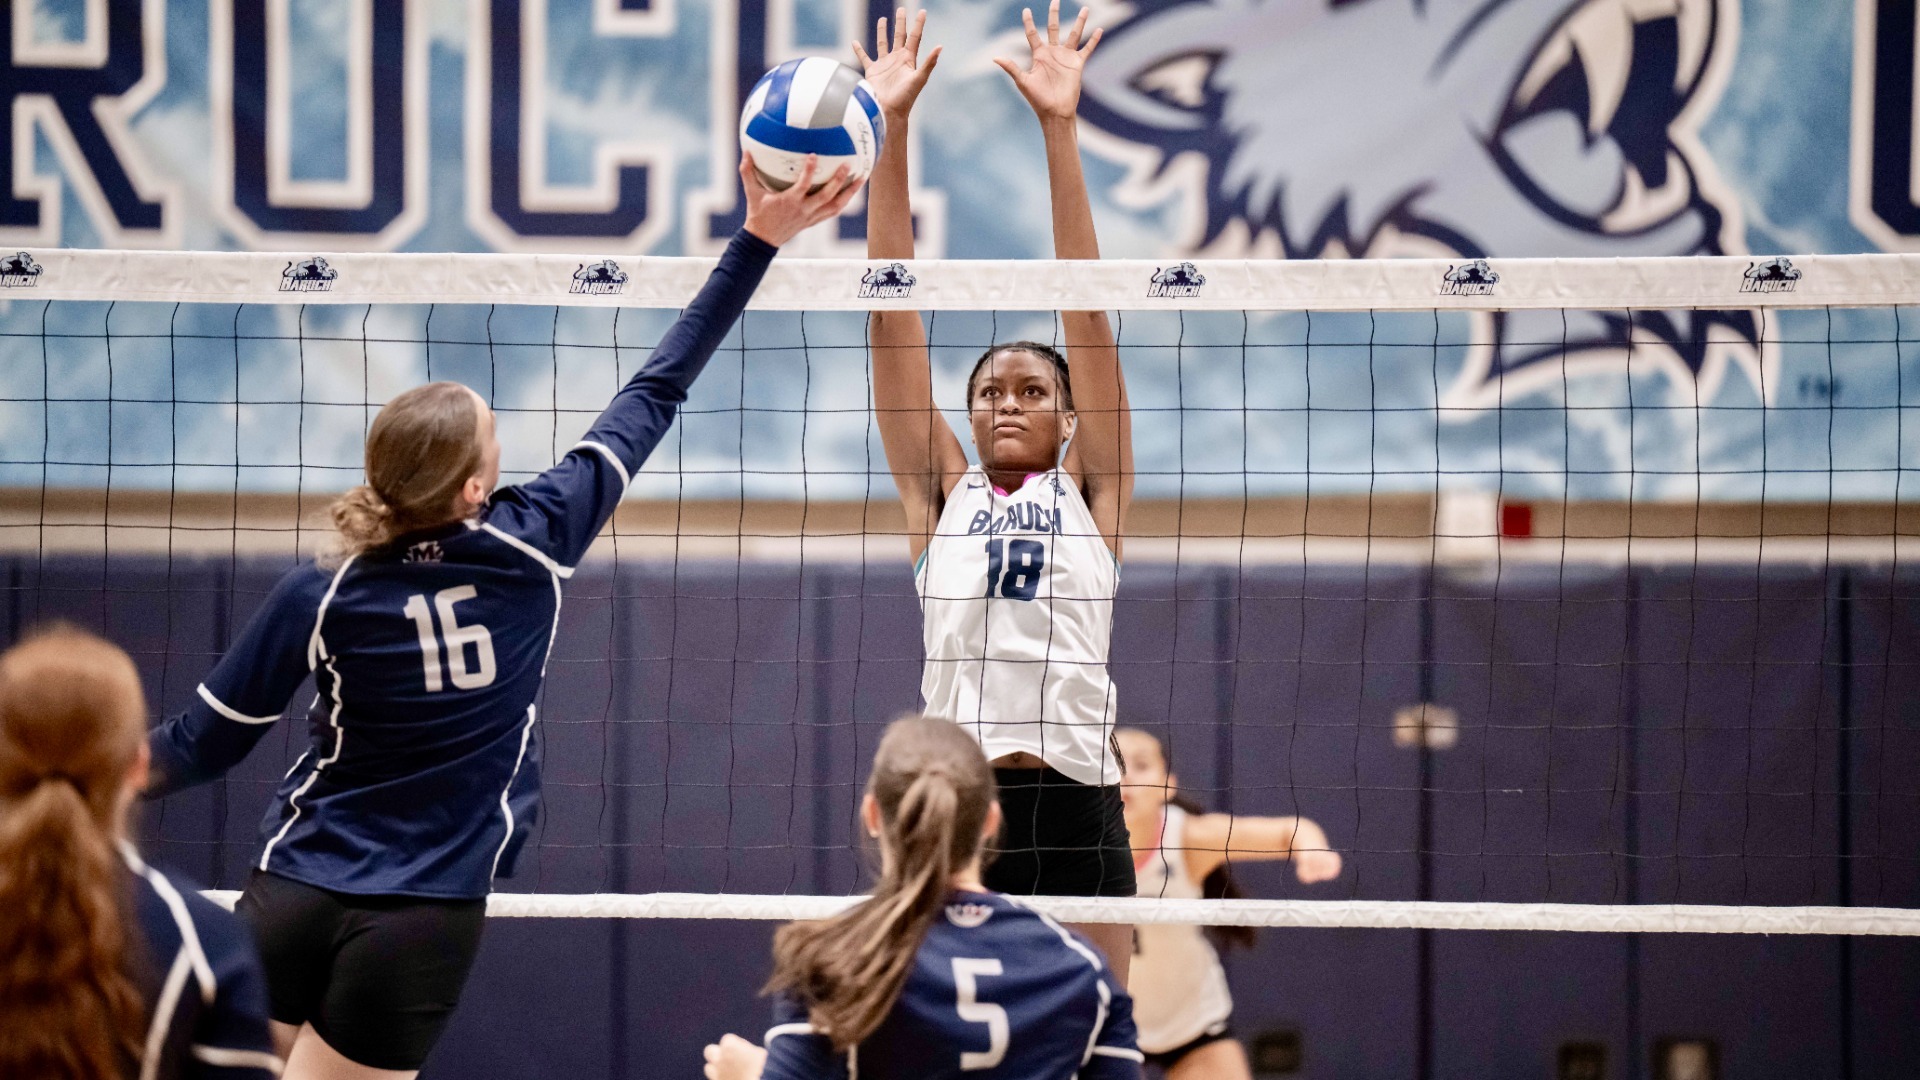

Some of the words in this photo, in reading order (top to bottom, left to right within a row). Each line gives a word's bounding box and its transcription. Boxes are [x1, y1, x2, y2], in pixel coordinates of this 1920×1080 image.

[278, 276, 333, 292] BARUCH
[569, 278, 623, 295] BARUCH
[858, 282, 912, 299] BARUCH
[1147, 282, 1201, 299] BARUCH
[1440, 279, 1495, 297] BARUCH
[1739, 277, 1797, 293] BARUCH
[968, 501, 1062, 537] BARUCH
[985, 538, 1044, 601] 18
[403, 584, 497, 692] 16
[951, 957, 1010, 1072] 5
